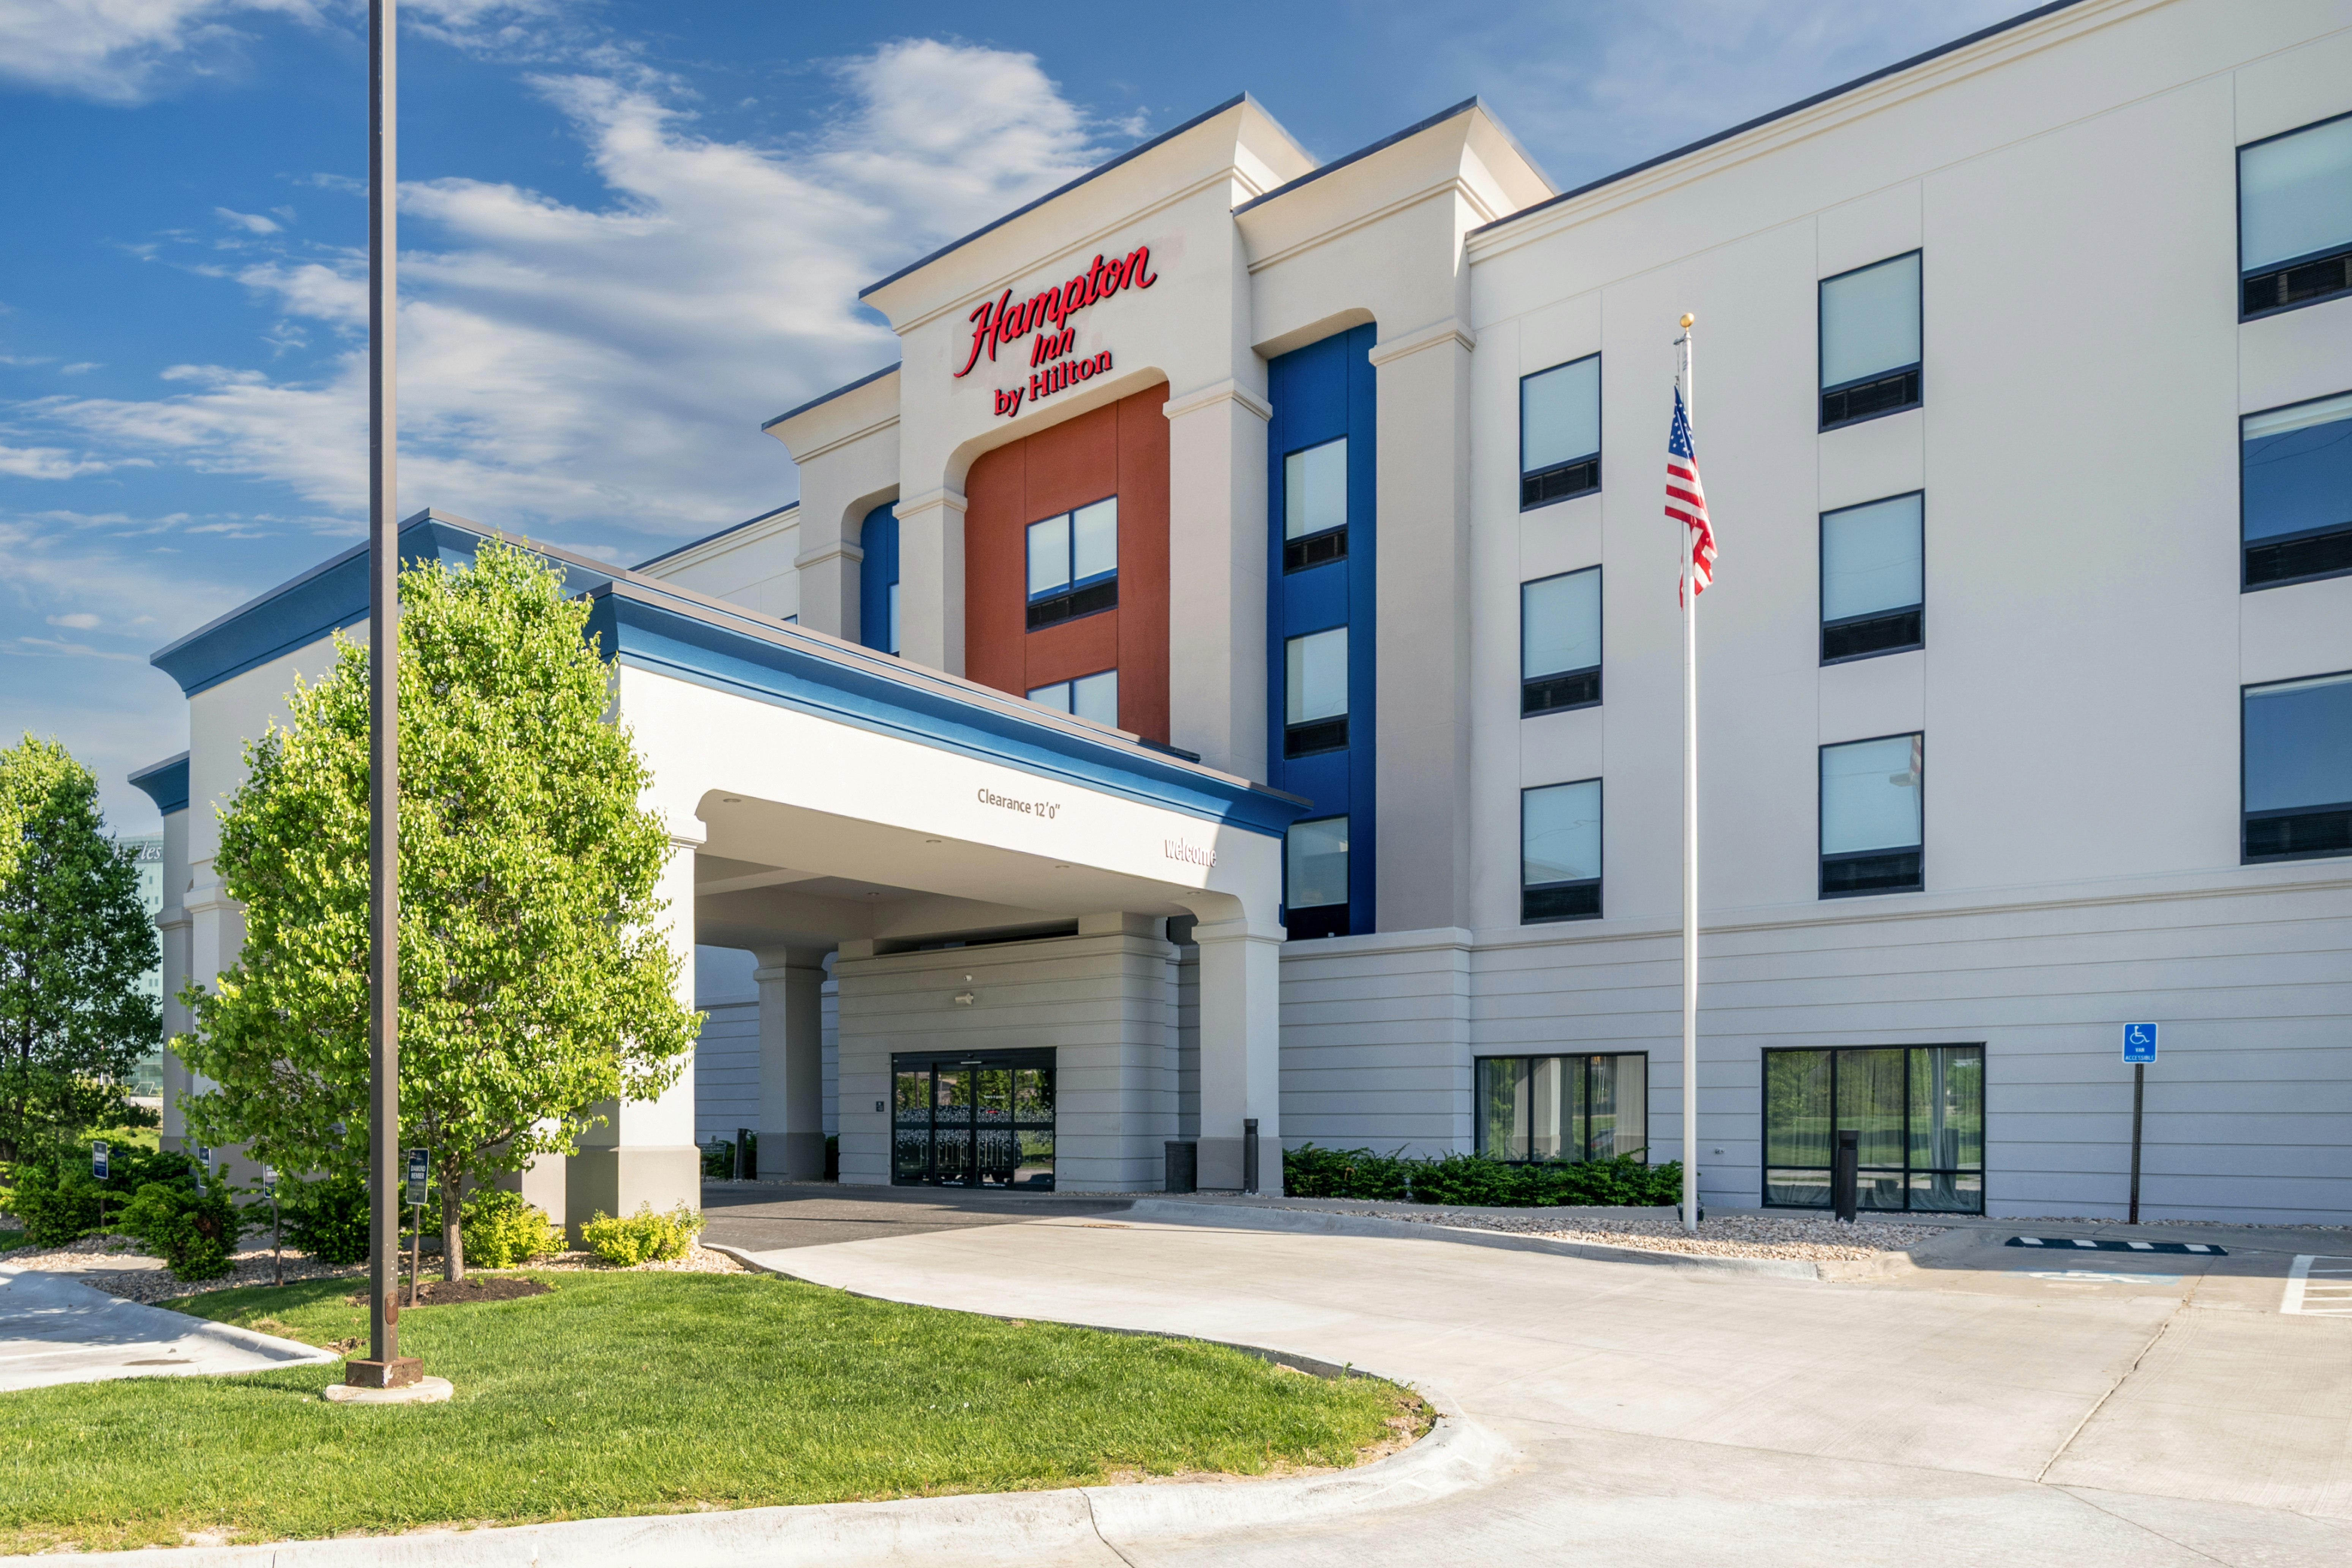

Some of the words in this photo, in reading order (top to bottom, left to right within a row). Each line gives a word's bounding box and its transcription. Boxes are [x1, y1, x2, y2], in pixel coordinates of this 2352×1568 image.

[953, 245, 1157, 378] Hampton
[1030, 326, 1075, 367] Inn
[994, 386, 1025, 417] by
[1028, 350, 1113, 402] Hilton
[977, 788, 1031, 814] Clearance
[1034, 801, 1061, 819] 12'0"
